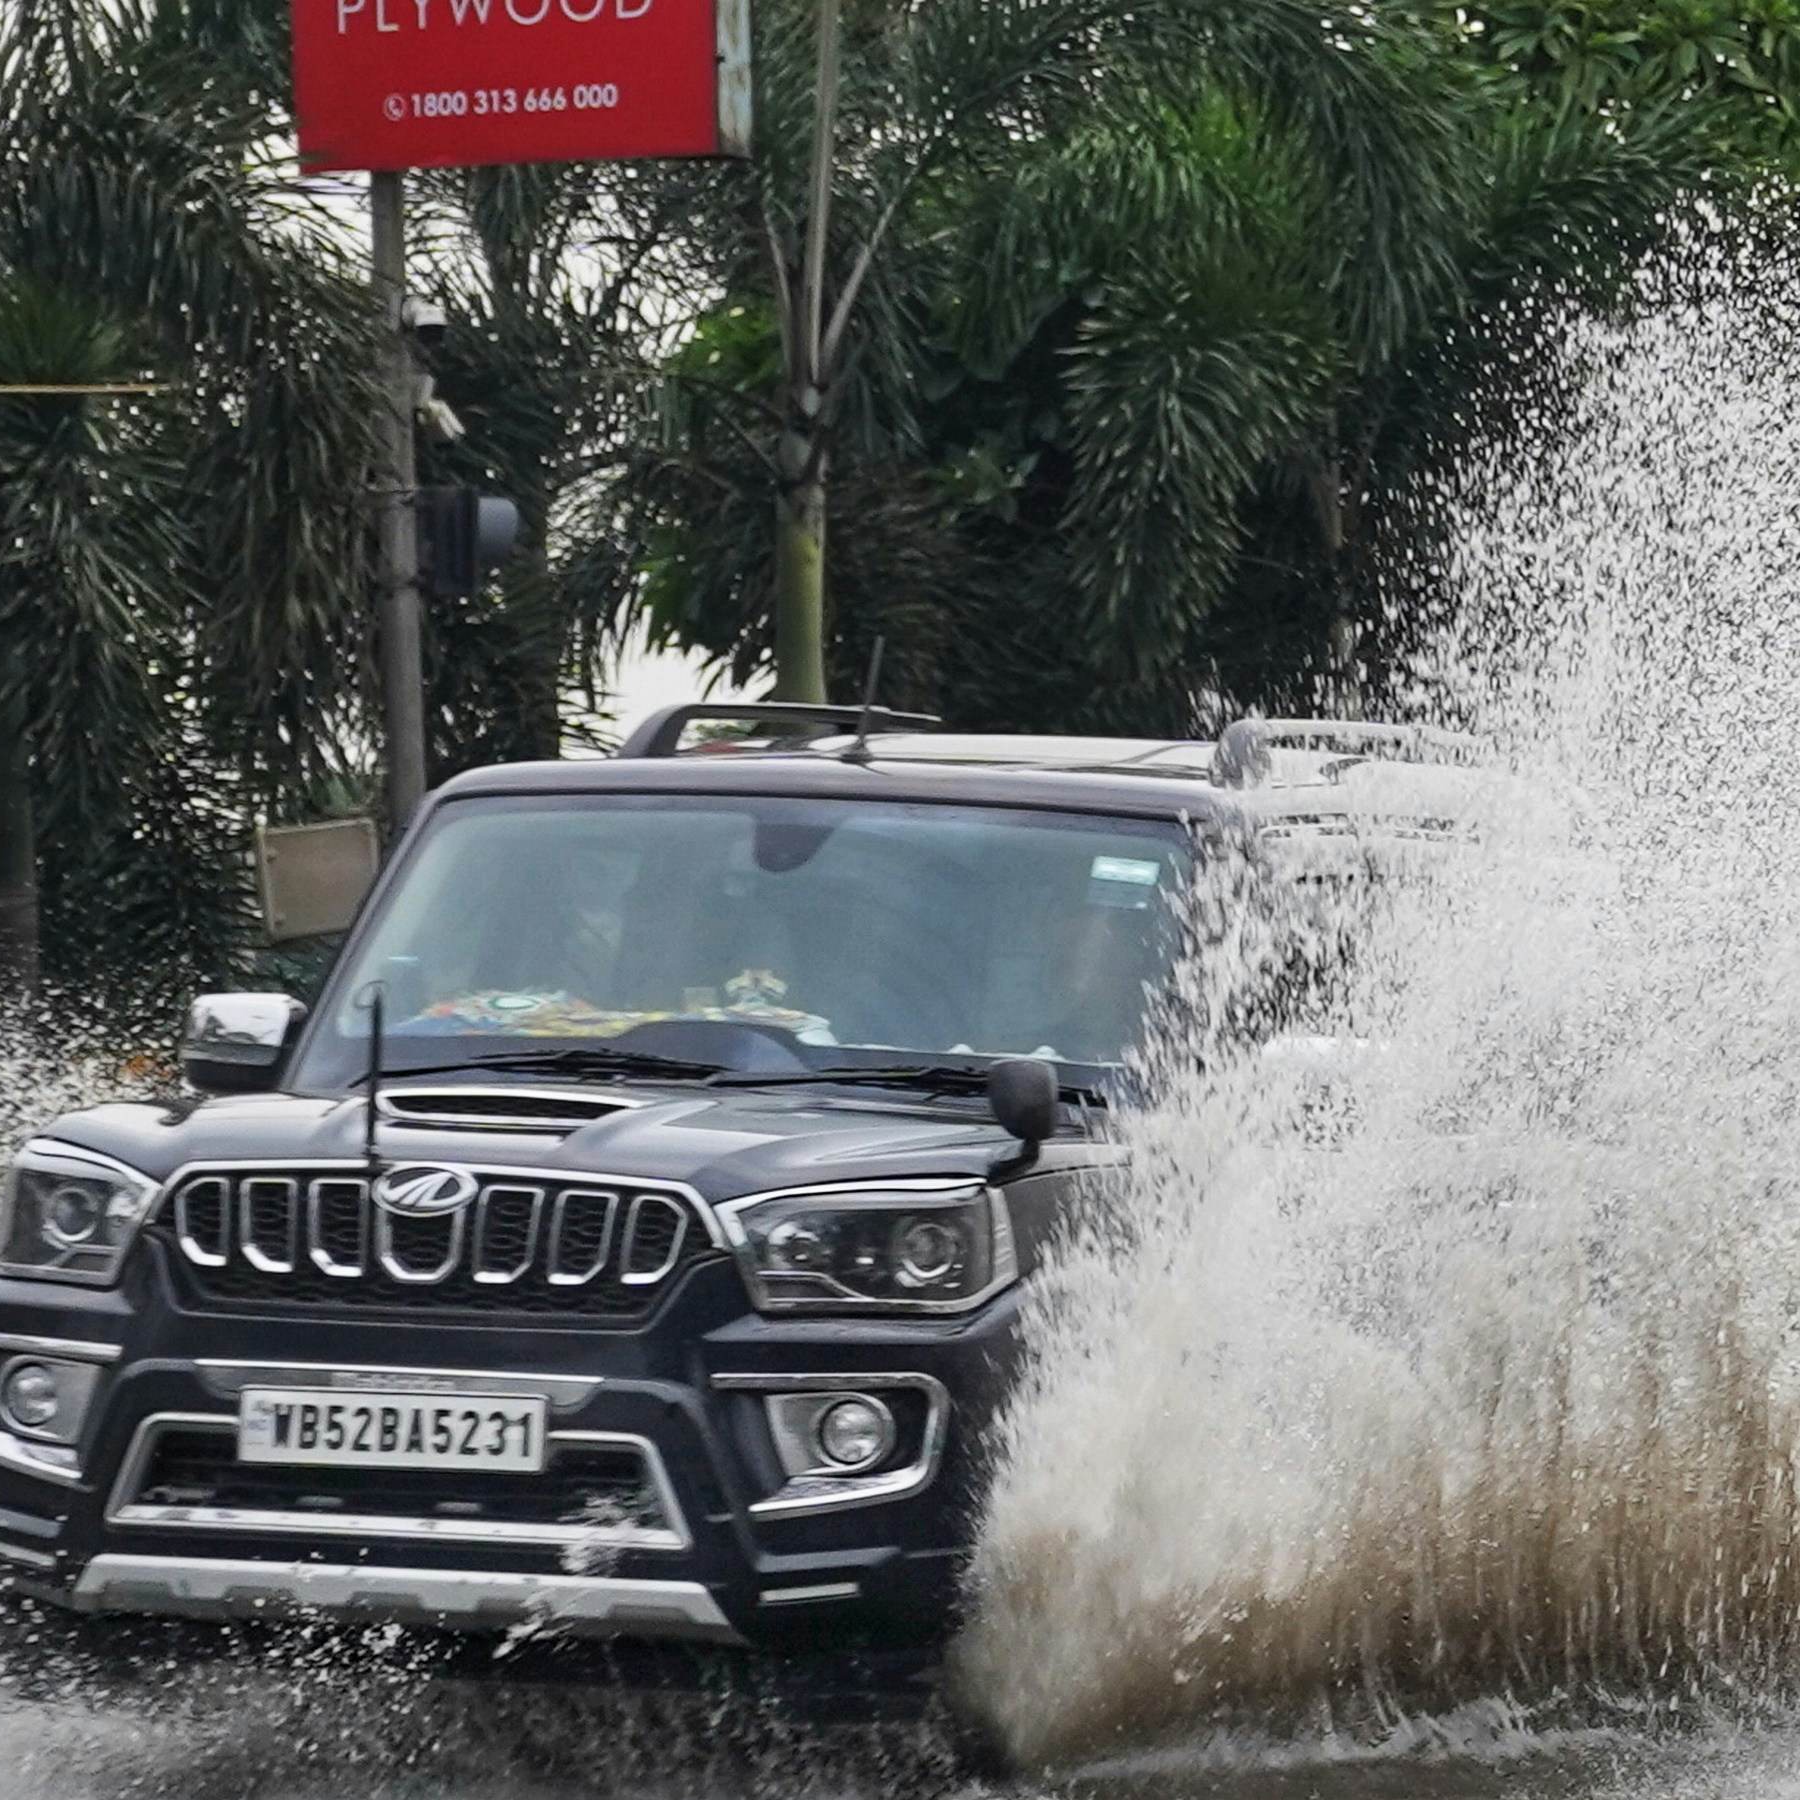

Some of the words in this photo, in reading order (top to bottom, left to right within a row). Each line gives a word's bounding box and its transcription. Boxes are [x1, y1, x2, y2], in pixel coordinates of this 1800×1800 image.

[410, 91, 468, 118] 1800
[473, 88, 518, 115] 313
[523, 86, 568, 113] 666
[573, 83, 619, 109] 000
[273, 1402, 534, 1459] WB52BA5231
